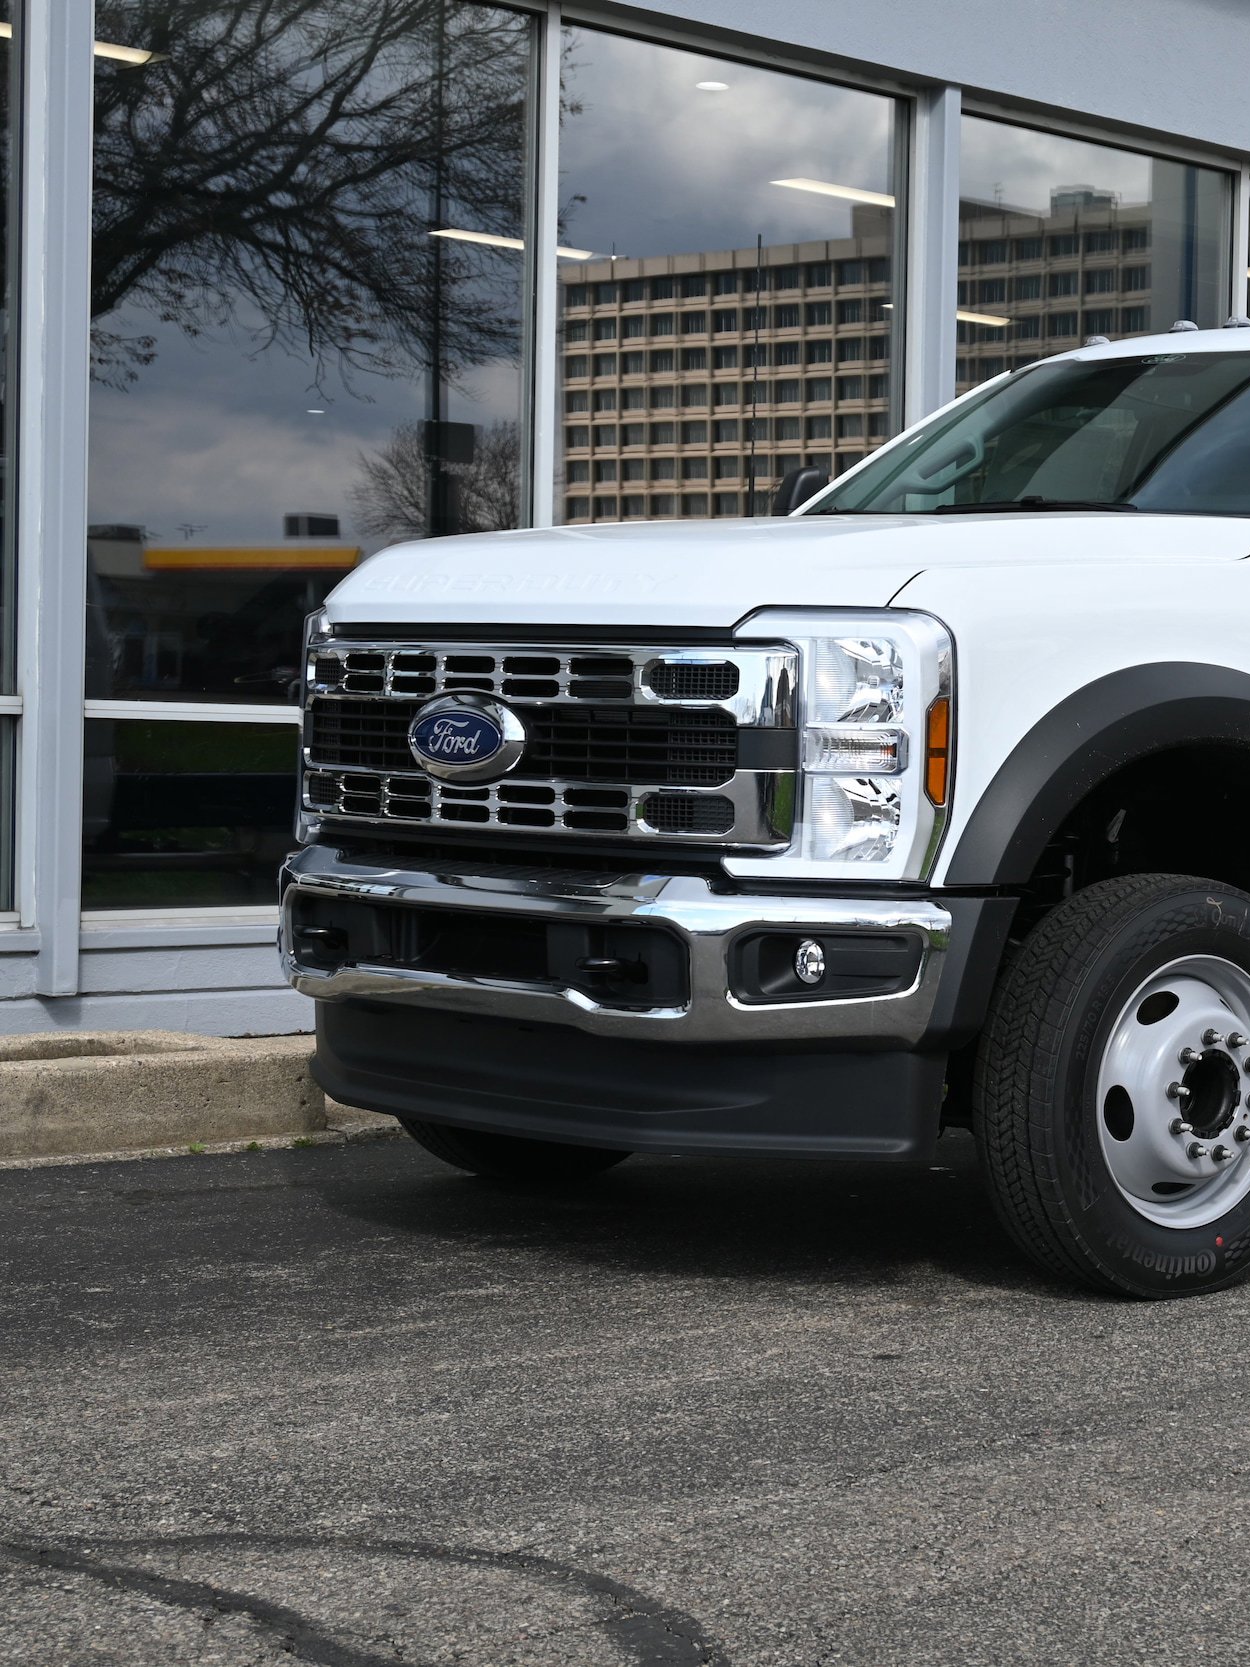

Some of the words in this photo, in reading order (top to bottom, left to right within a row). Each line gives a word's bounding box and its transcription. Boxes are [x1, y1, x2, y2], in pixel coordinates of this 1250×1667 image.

[362, 574, 513, 593] SUPER
[515, 574, 678, 593] DUTY
[428, 719, 481, 754] Ford
[1106, 1232, 1217, 1279] Continental
